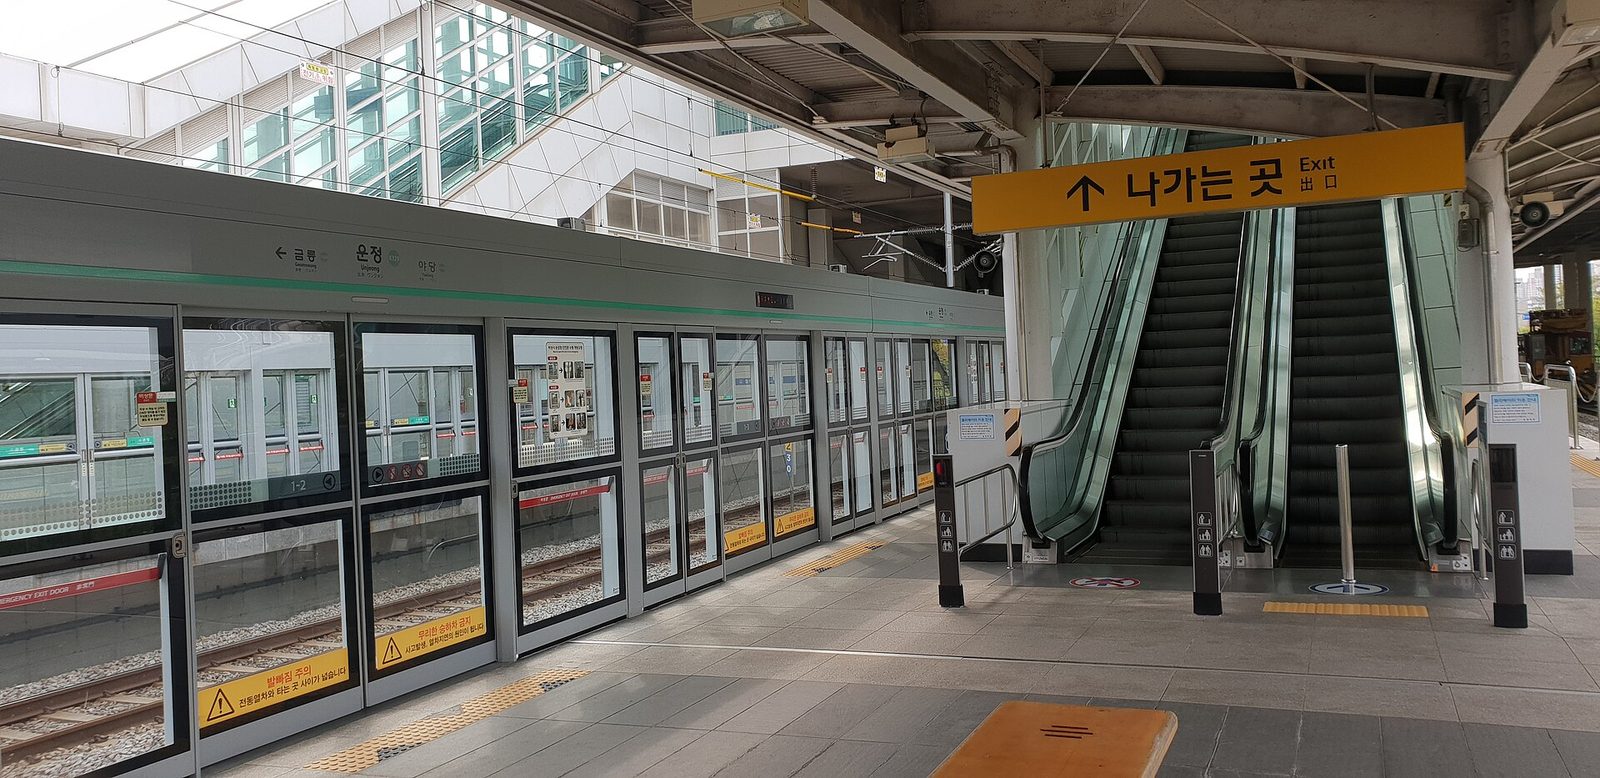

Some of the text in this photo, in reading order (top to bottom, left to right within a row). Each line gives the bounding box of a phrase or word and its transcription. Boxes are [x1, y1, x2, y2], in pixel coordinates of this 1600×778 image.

[1300, 156, 1335, 171] Exit
[1127, 158, 1283, 207] 나가는 곳
[356, 244, 382, 264] 운정
[418, 260, 436, 272] 야당
[291, 480, 306, 491] 1-2
[50, 586, 69, 595] DOOR
[418, 616, 471, 640] 무리한 승하차 금지
[267, 664, 312, 688] 발빠짐 주의
[239, 666, 346, 708] 전동열차와 타는 곳 사이가 넓습니다
